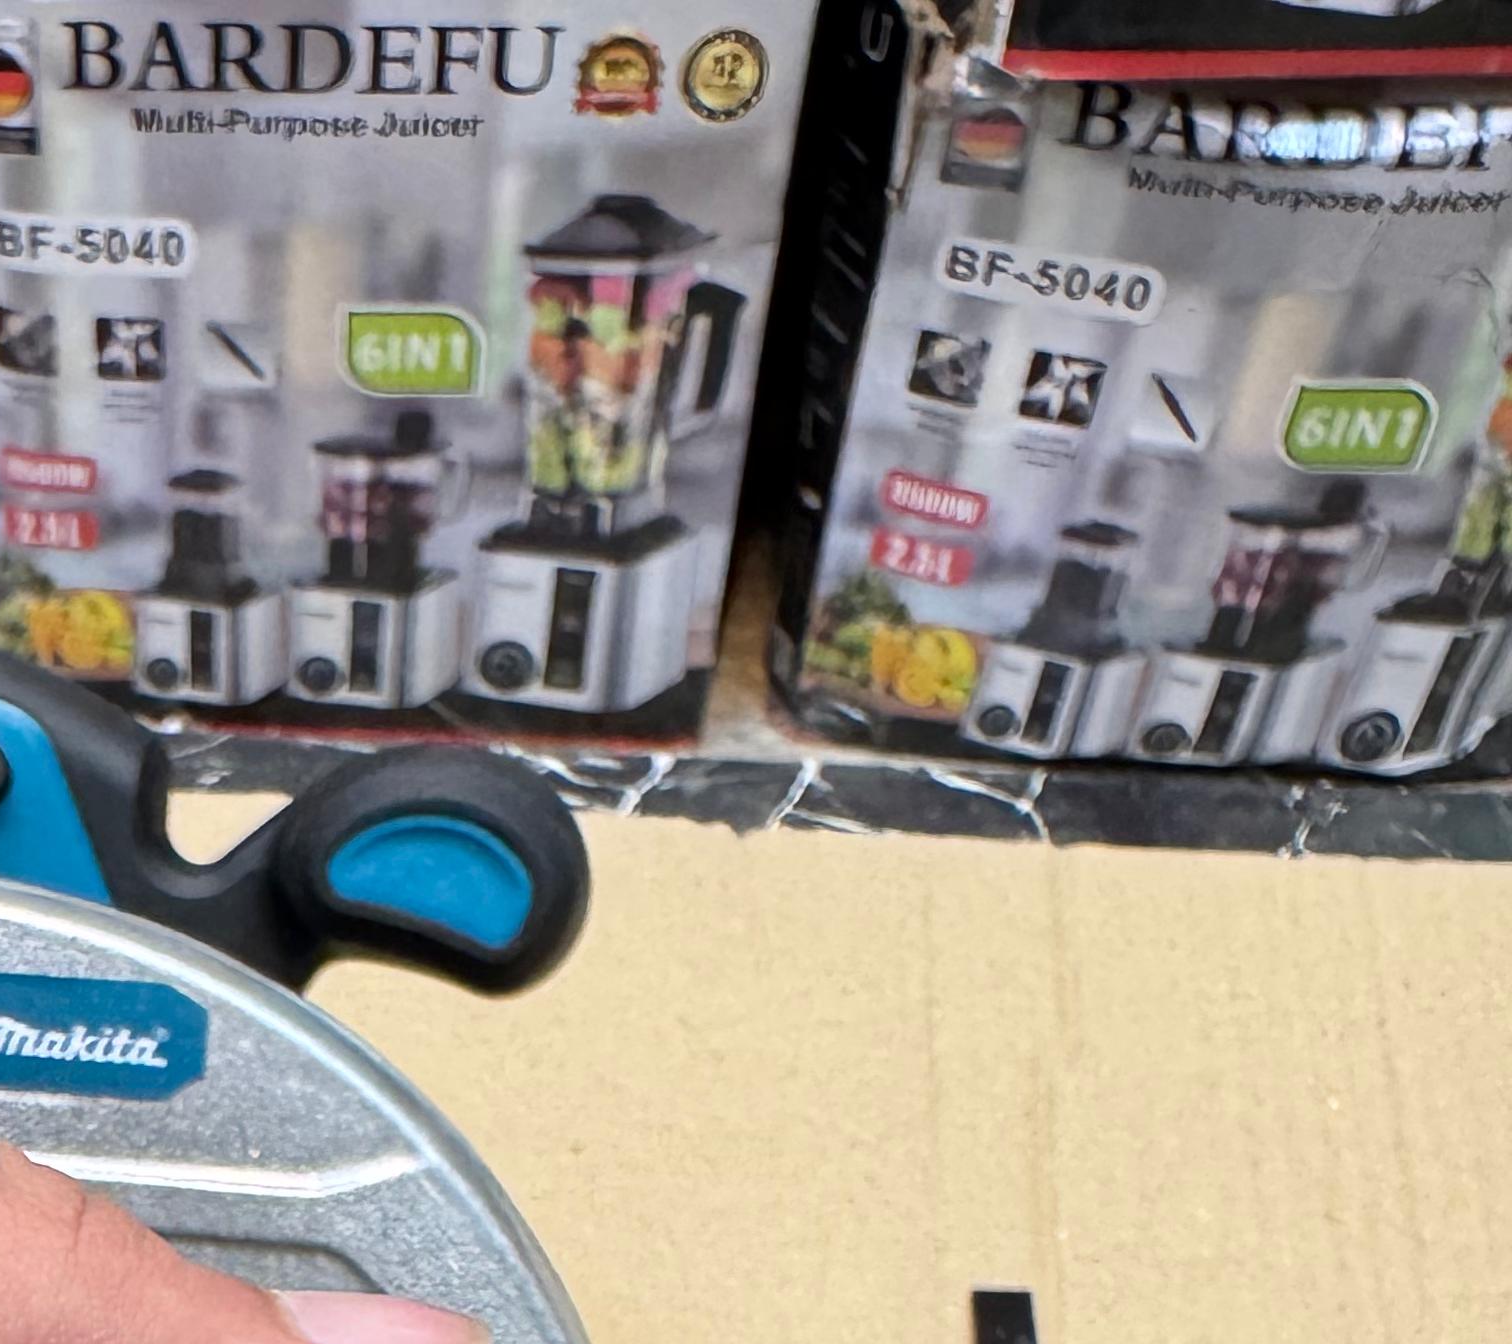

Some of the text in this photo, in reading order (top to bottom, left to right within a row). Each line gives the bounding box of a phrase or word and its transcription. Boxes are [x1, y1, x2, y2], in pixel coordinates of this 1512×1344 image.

[63, 20, 566, 97] BARDEFU
[131, 108, 368, 141] Multi-Purpose
[945, 245, 1152, 312] BF-5040
